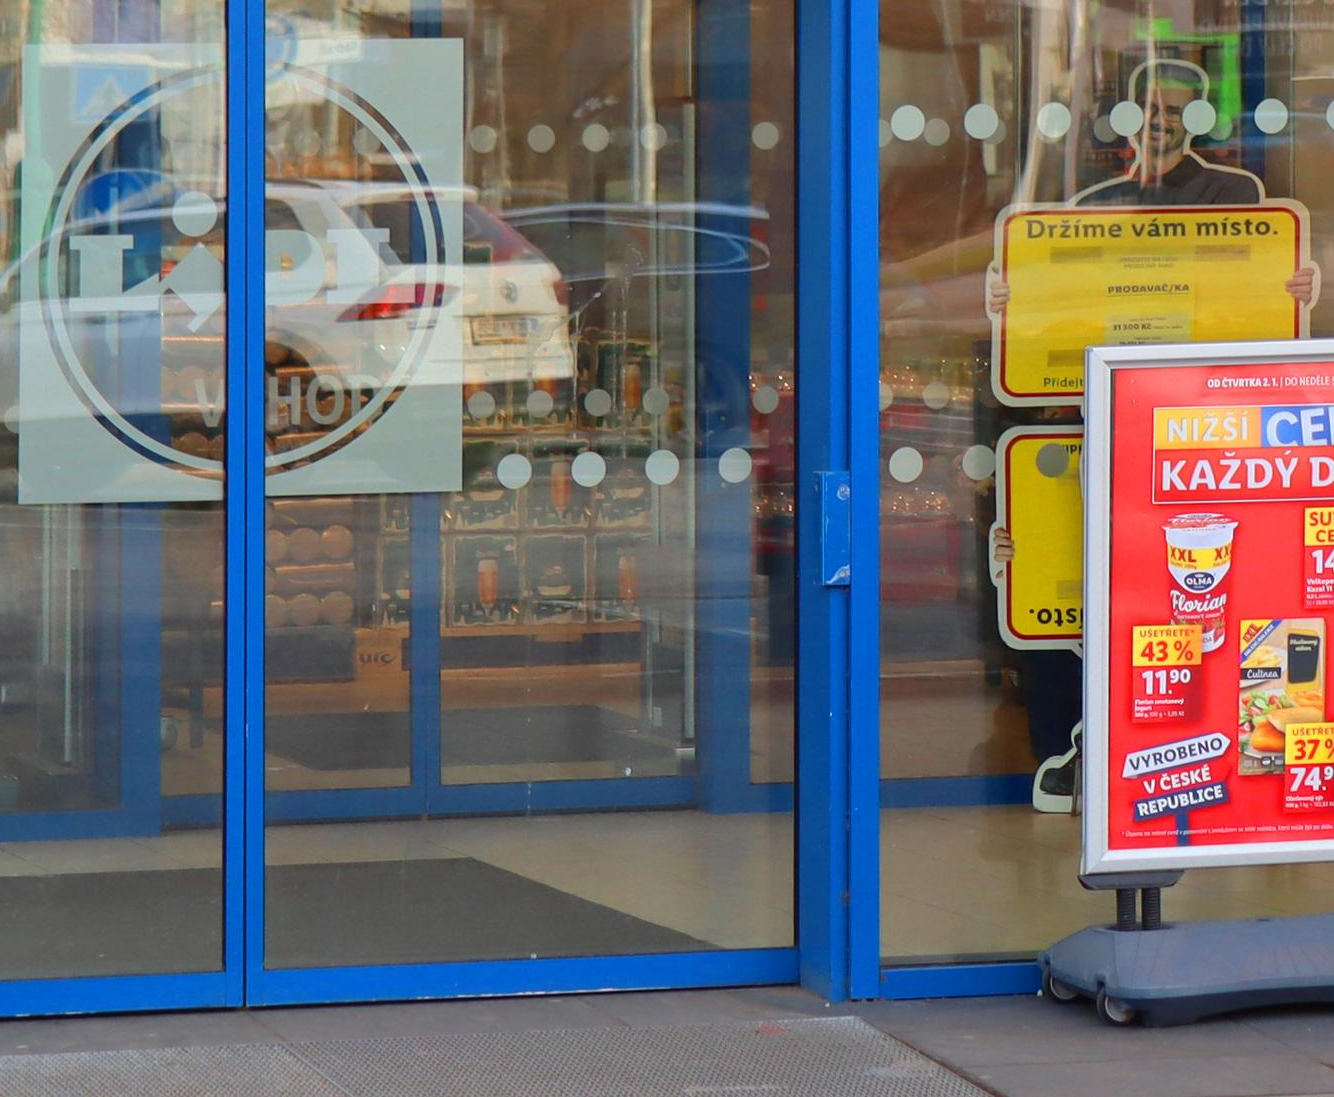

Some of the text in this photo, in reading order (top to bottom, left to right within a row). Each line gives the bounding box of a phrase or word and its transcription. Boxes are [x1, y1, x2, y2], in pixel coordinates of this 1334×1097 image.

[1027, 218, 1279, 239] Držíme vám místo.
[1043, 376, 1085, 390] Přidejt
[1207, 377, 1220, 388] OD
[1221, 375, 1262, 388] ČTVRTKA
[1262, 377, 1272, 387] 2.
[1284, 377, 1298, 386] DO
[1299, 375, 1330, 386] NEDĚLE
[1166, 410, 1248, 443] NIŽŠÍ
[1162, 450, 1301, 492] KAŽDÝ
[1170, 546, 1197, 563] XXL
[1186, 577, 1213, 585] OLMA
[1170, 590, 1227, 612] Florian
[1029, 607, 1084, 630] ísto.
[1140, 640, 1194, 662] 43 %
[1246, 669, 1279, 679] Culinea
[1129, 737, 1223, 771] VYROBENO
[1294, 739, 1321, 761] 37
[1143, 764, 1212, 794] V ČESKÉ
[1136, 785, 1223, 817] REPUBLICE
